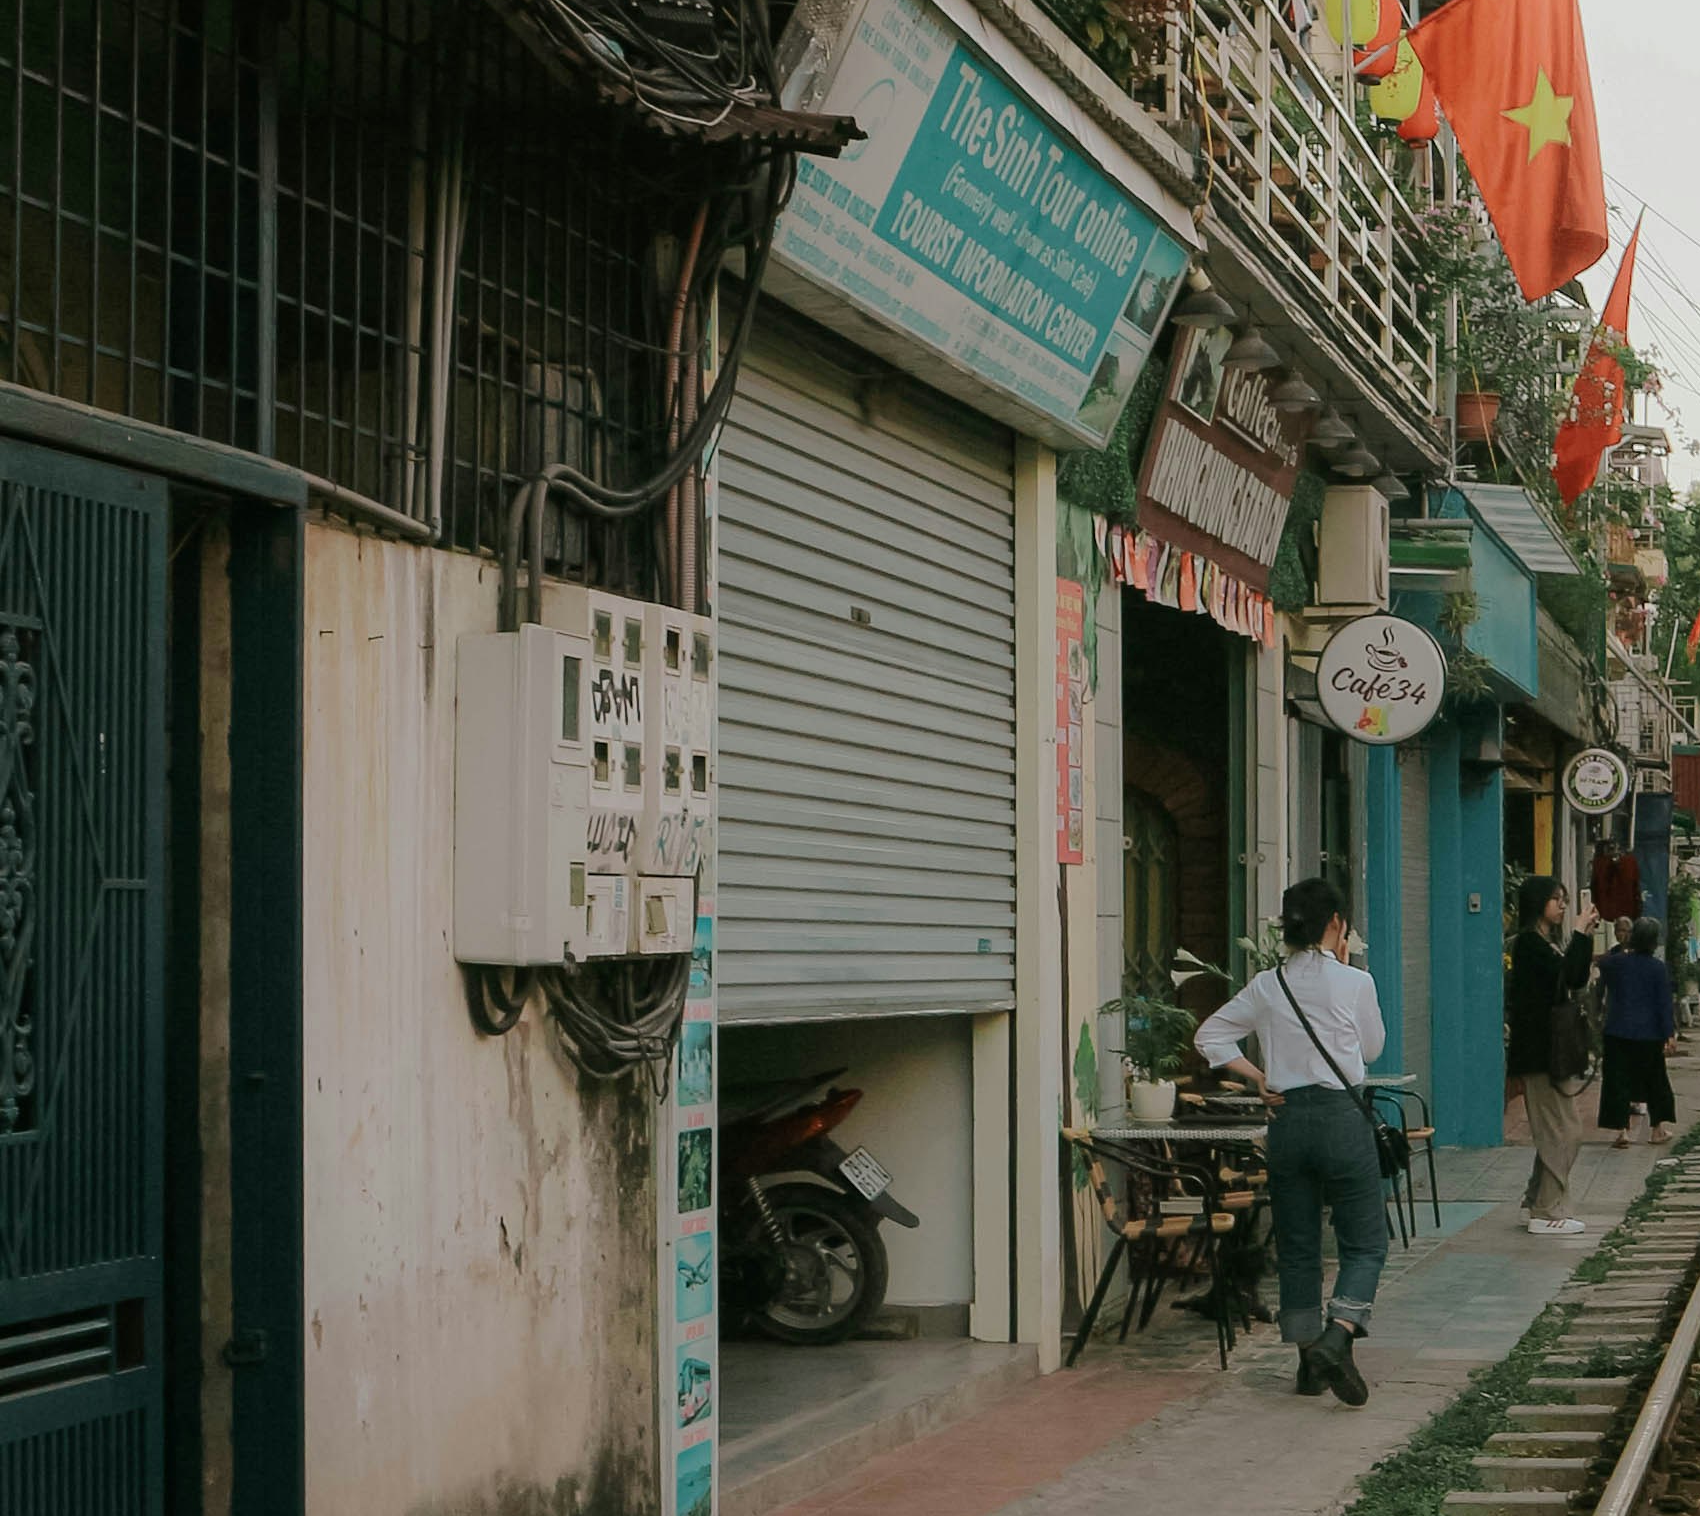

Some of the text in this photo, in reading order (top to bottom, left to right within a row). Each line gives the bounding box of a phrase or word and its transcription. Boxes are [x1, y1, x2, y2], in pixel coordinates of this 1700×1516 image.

[890, 189, 965, 269] TOURIST
[951, 237, 1055, 333] INFORMATION
[1044, 302, 1099, 363] CENTER
[1031, 144, 1086, 231] Tour
[1074, 199, 1138, 278] online
